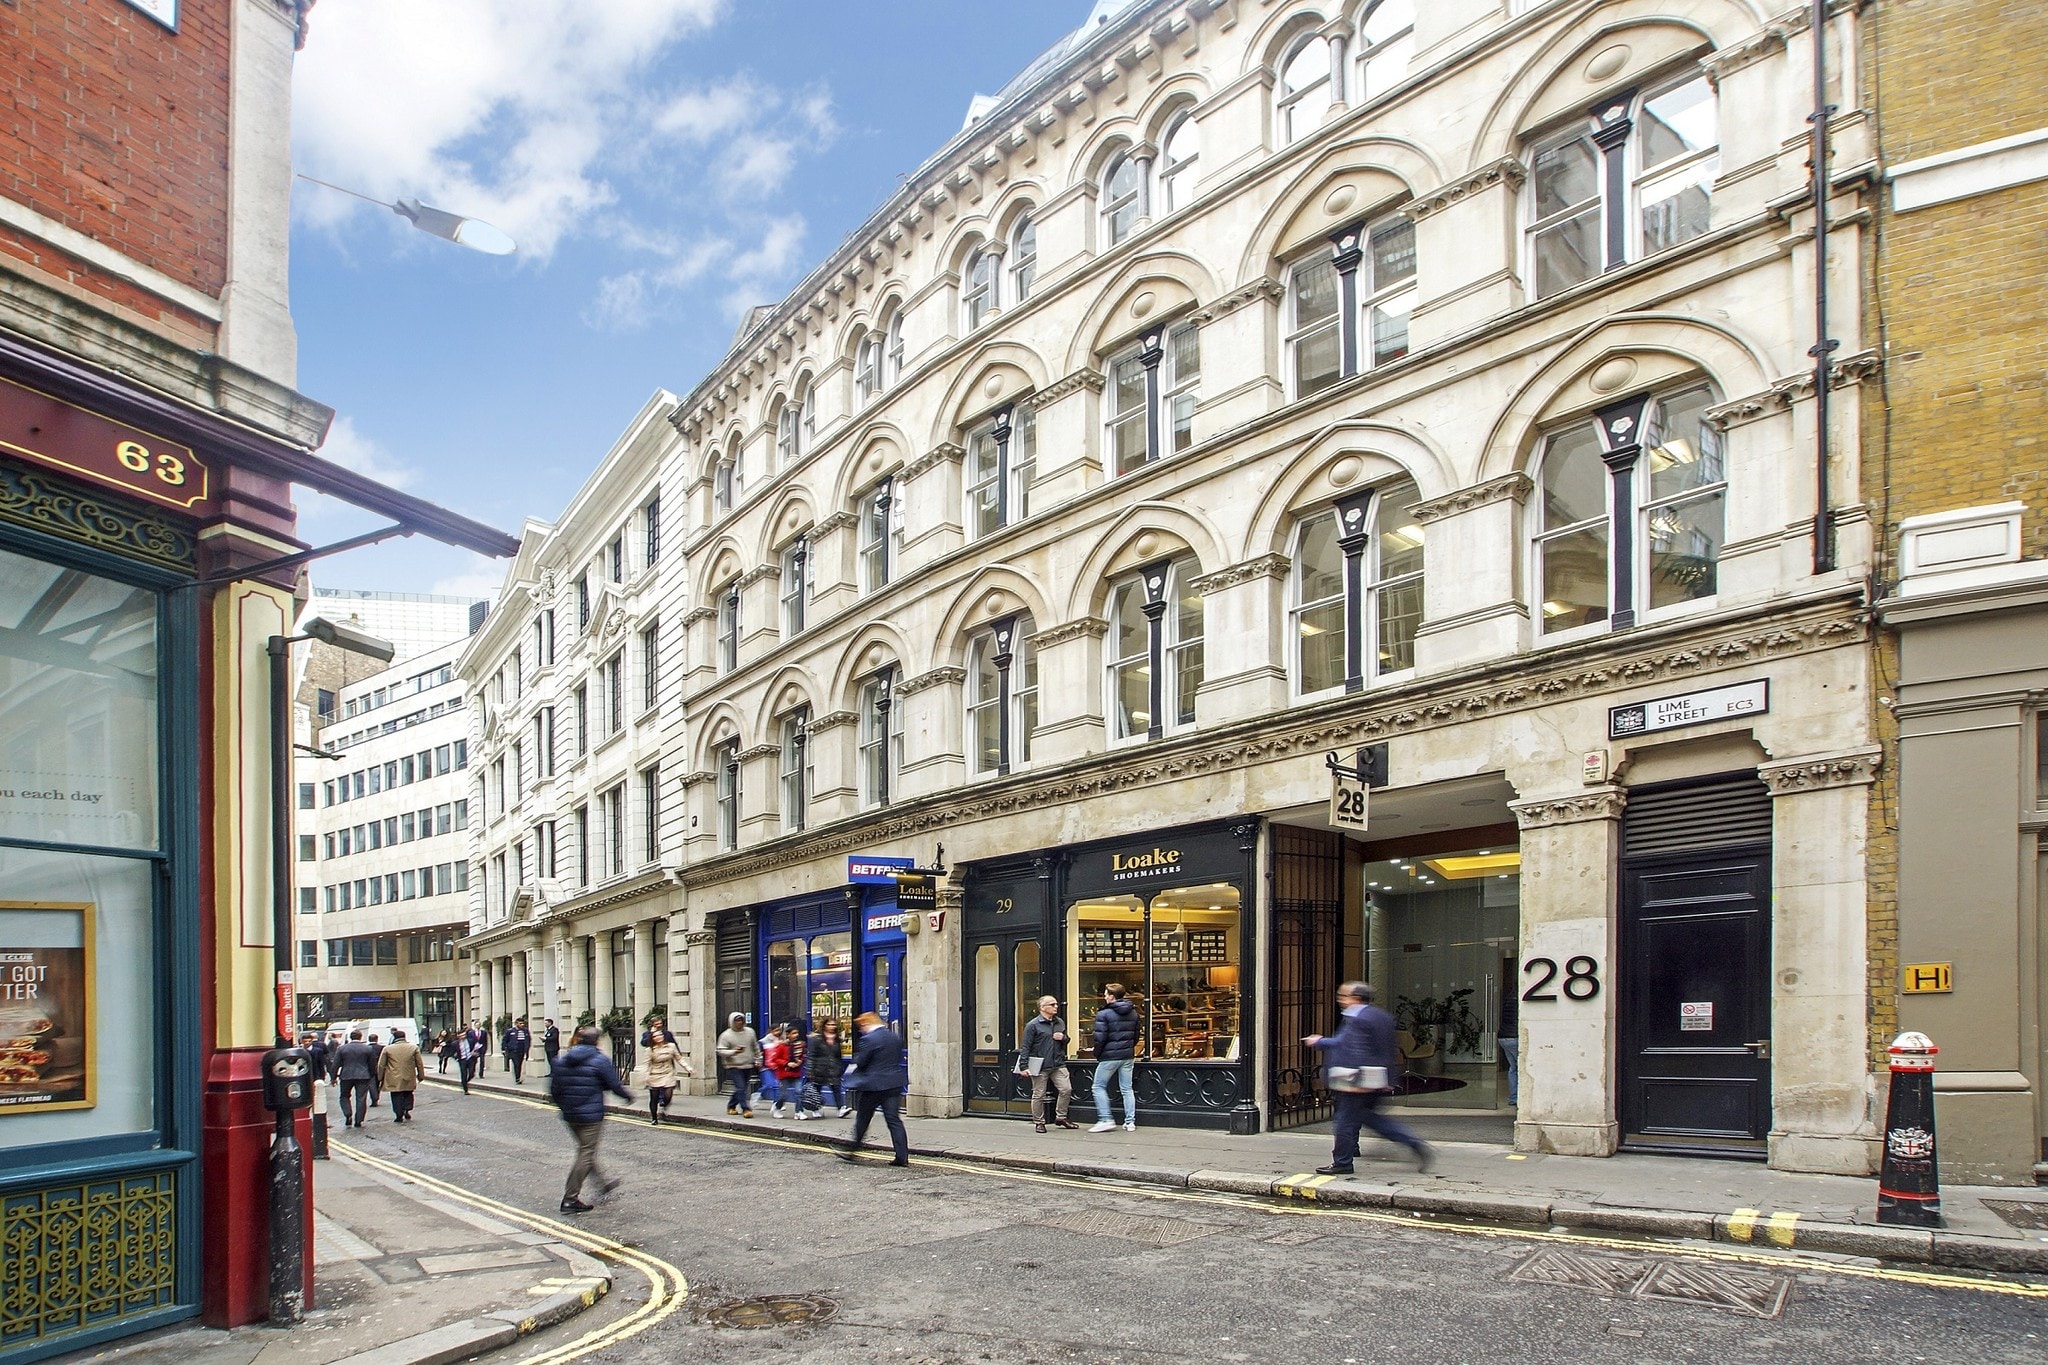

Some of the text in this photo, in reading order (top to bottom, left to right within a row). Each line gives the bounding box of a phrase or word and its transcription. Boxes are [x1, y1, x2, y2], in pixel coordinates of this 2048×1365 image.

[116, 440, 186, 486] 63
[1658, 699, 1691, 714] LIME
[1727, 699, 1754, 712] EC3
[1658, 707, 1709, 725] STREET
[21, 789, 65, 801] each
[71, 790, 104, 804] day
[1337, 788, 1365, 815] 28
[1112, 848, 1180, 872] Loake
[1113, 866, 1181, 880] SHOEMAKERS
[899, 884, 934, 896] Loake
[996, 898, 1013, 914] 29
[12, 965, 48, 983] GOT
[1522, 955, 1600, 1002] 28
[0, 983, 38, 1000] TER
